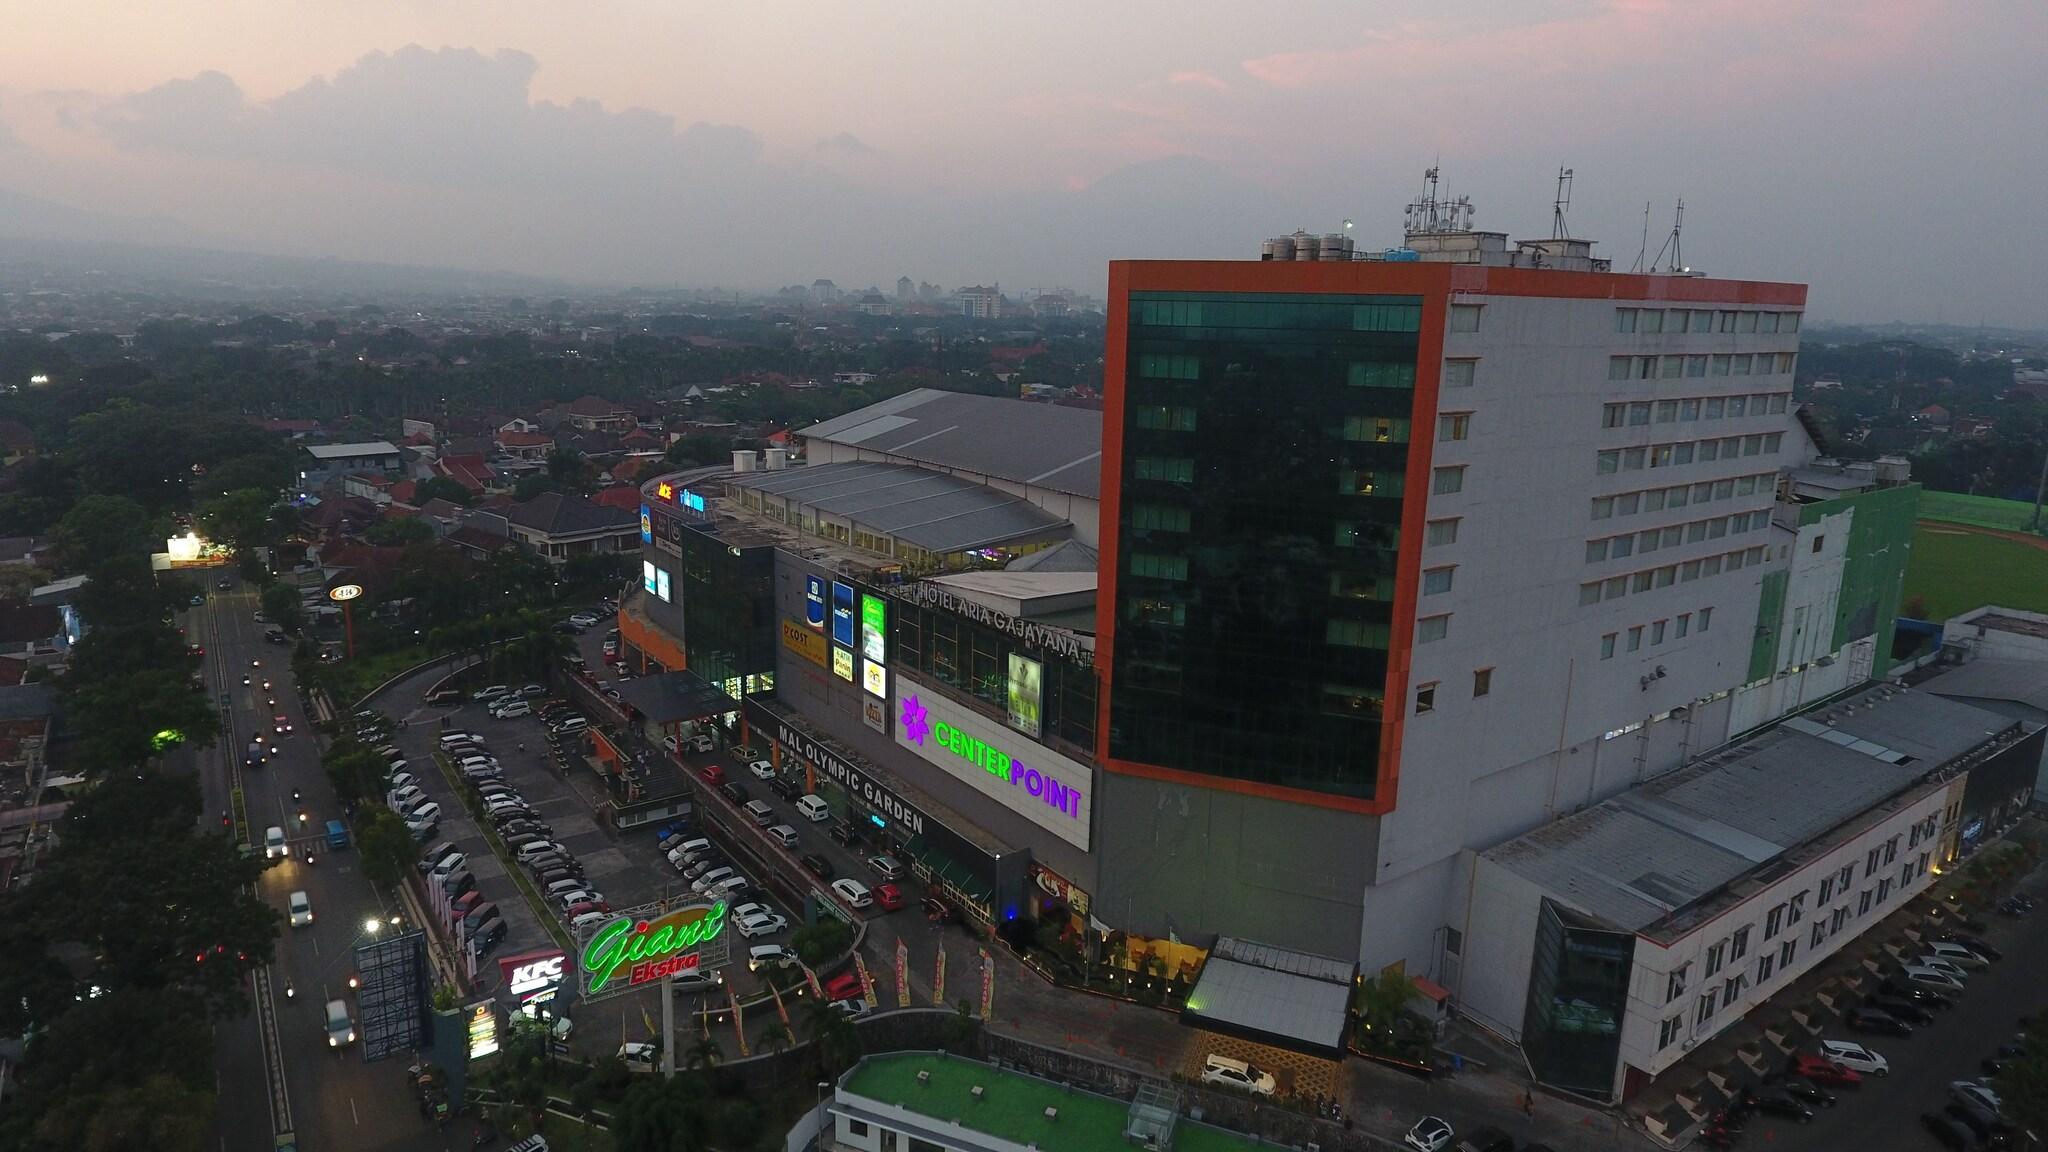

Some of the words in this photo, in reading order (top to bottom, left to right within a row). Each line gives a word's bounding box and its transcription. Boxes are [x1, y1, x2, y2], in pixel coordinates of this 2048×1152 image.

[658, 481, 672, 500] ACE
[920, 581, 955, 611] HOTEL
[958, 597, 991, 625] ARIA
[994, 611, 1080, 659] GAJAYANA
[779, 725, 802, 753] MAL
[806, 743, 860, 791] OLYMPIC
[864, 782, 923, 835] GARDEN
[934, 719, 1082, 819] CENTERPOINT
[510, 956, 566, 986] KFC
[584, 900, 727, 994] Giant
[630, 952, 699, 985] Ekstra
